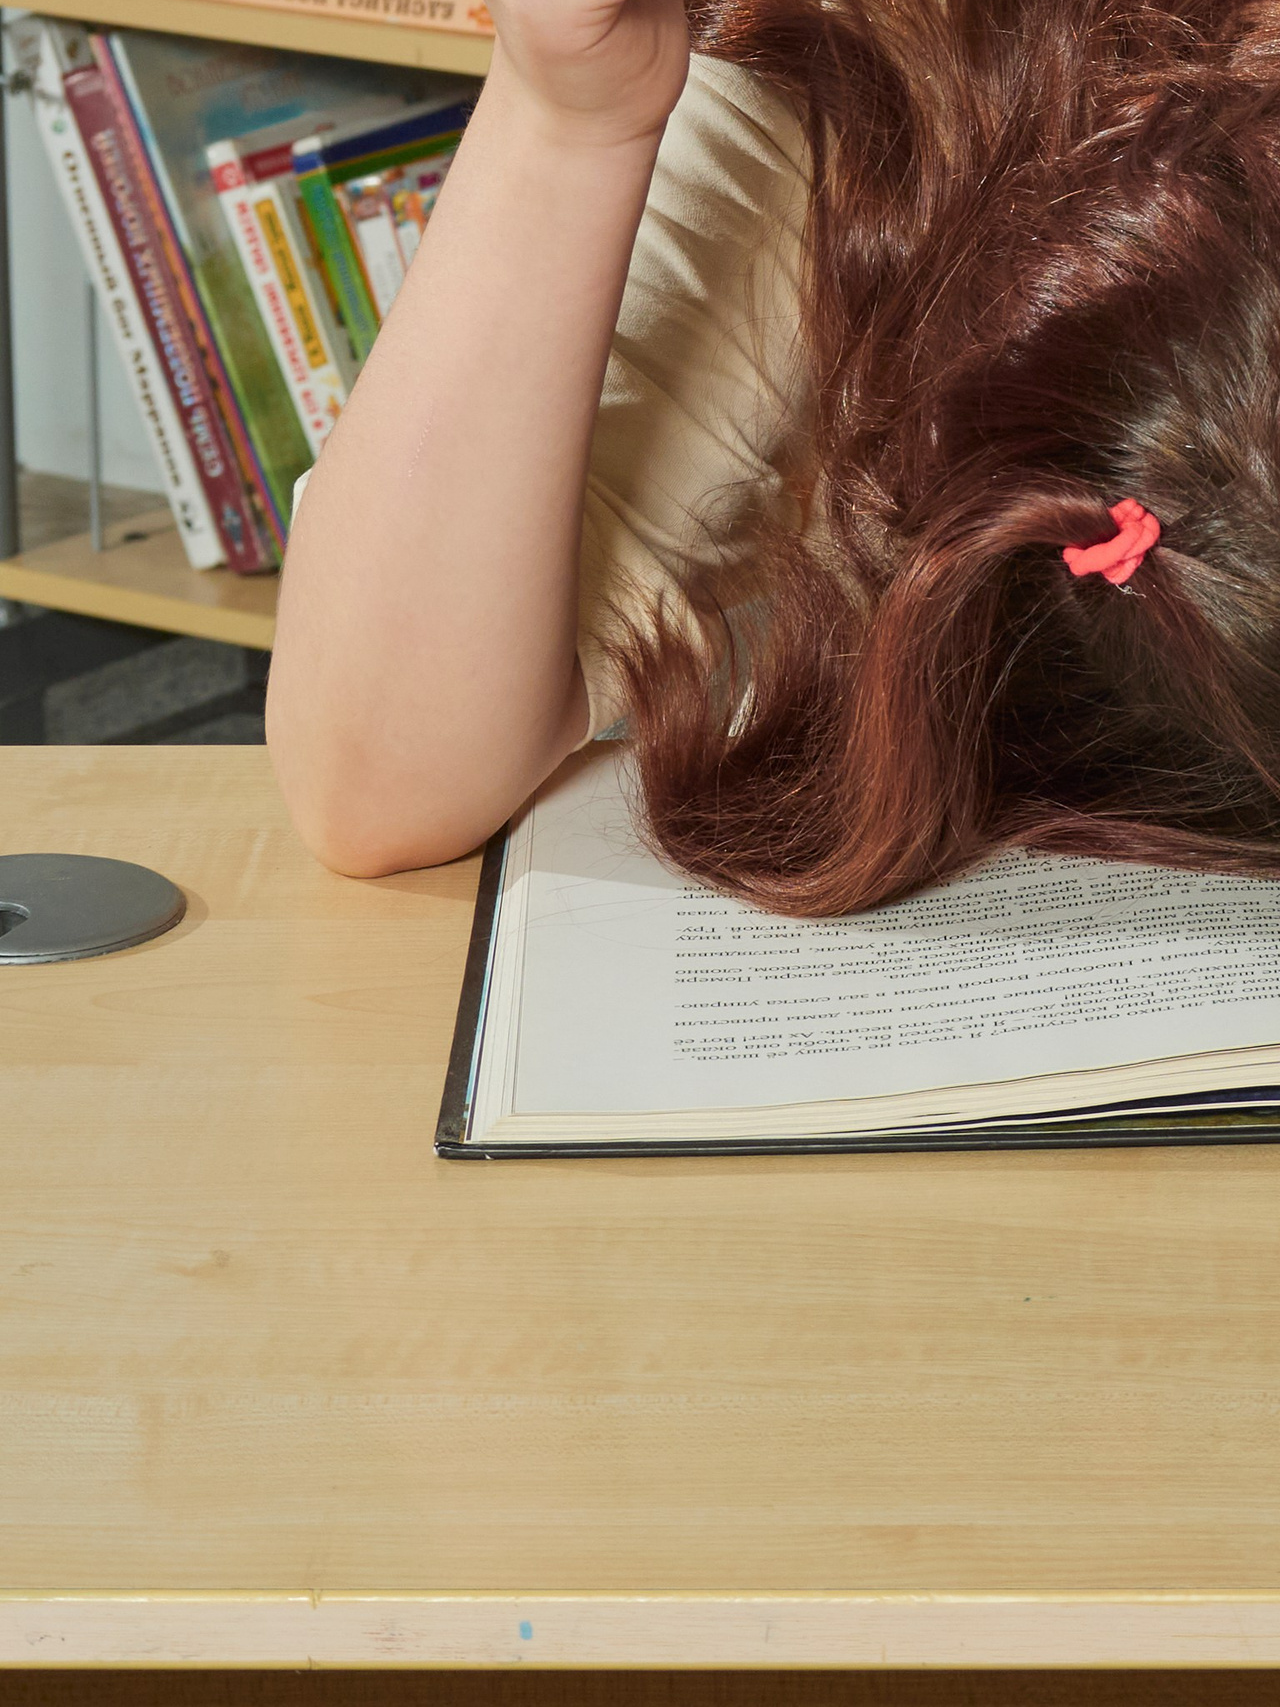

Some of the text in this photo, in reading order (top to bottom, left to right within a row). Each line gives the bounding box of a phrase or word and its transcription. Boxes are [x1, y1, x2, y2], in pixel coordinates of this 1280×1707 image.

[61, 151, 119, 292] Огненный
[107, 295, 136, 341] бог
[136, 248, 203, 406] ПОДЗЕМНЫХ
[1162, 981, 1236, 994] лёгкой.
[1061, 992, 1154, 1007] Королева
[1116, 990, 1233, 1009] проговорил
[980, 1004, 1055, 1018] должна
[1032, 1006, 1106, 1018] король.
[1127, 1006, 1174, 1016] тихо
[898, 1016, 972, 1028] кое-что
[991, 1020, 1077, 1035] ступает?
[821, 1026, 891, 1034] весить.
[900, 1027, 953, 1037] хотел
[789, 1038, 850, 1047] чтобы
[899, 1036, 962, 1045] что-то
[795, 1046, 861, 1055] слышу
